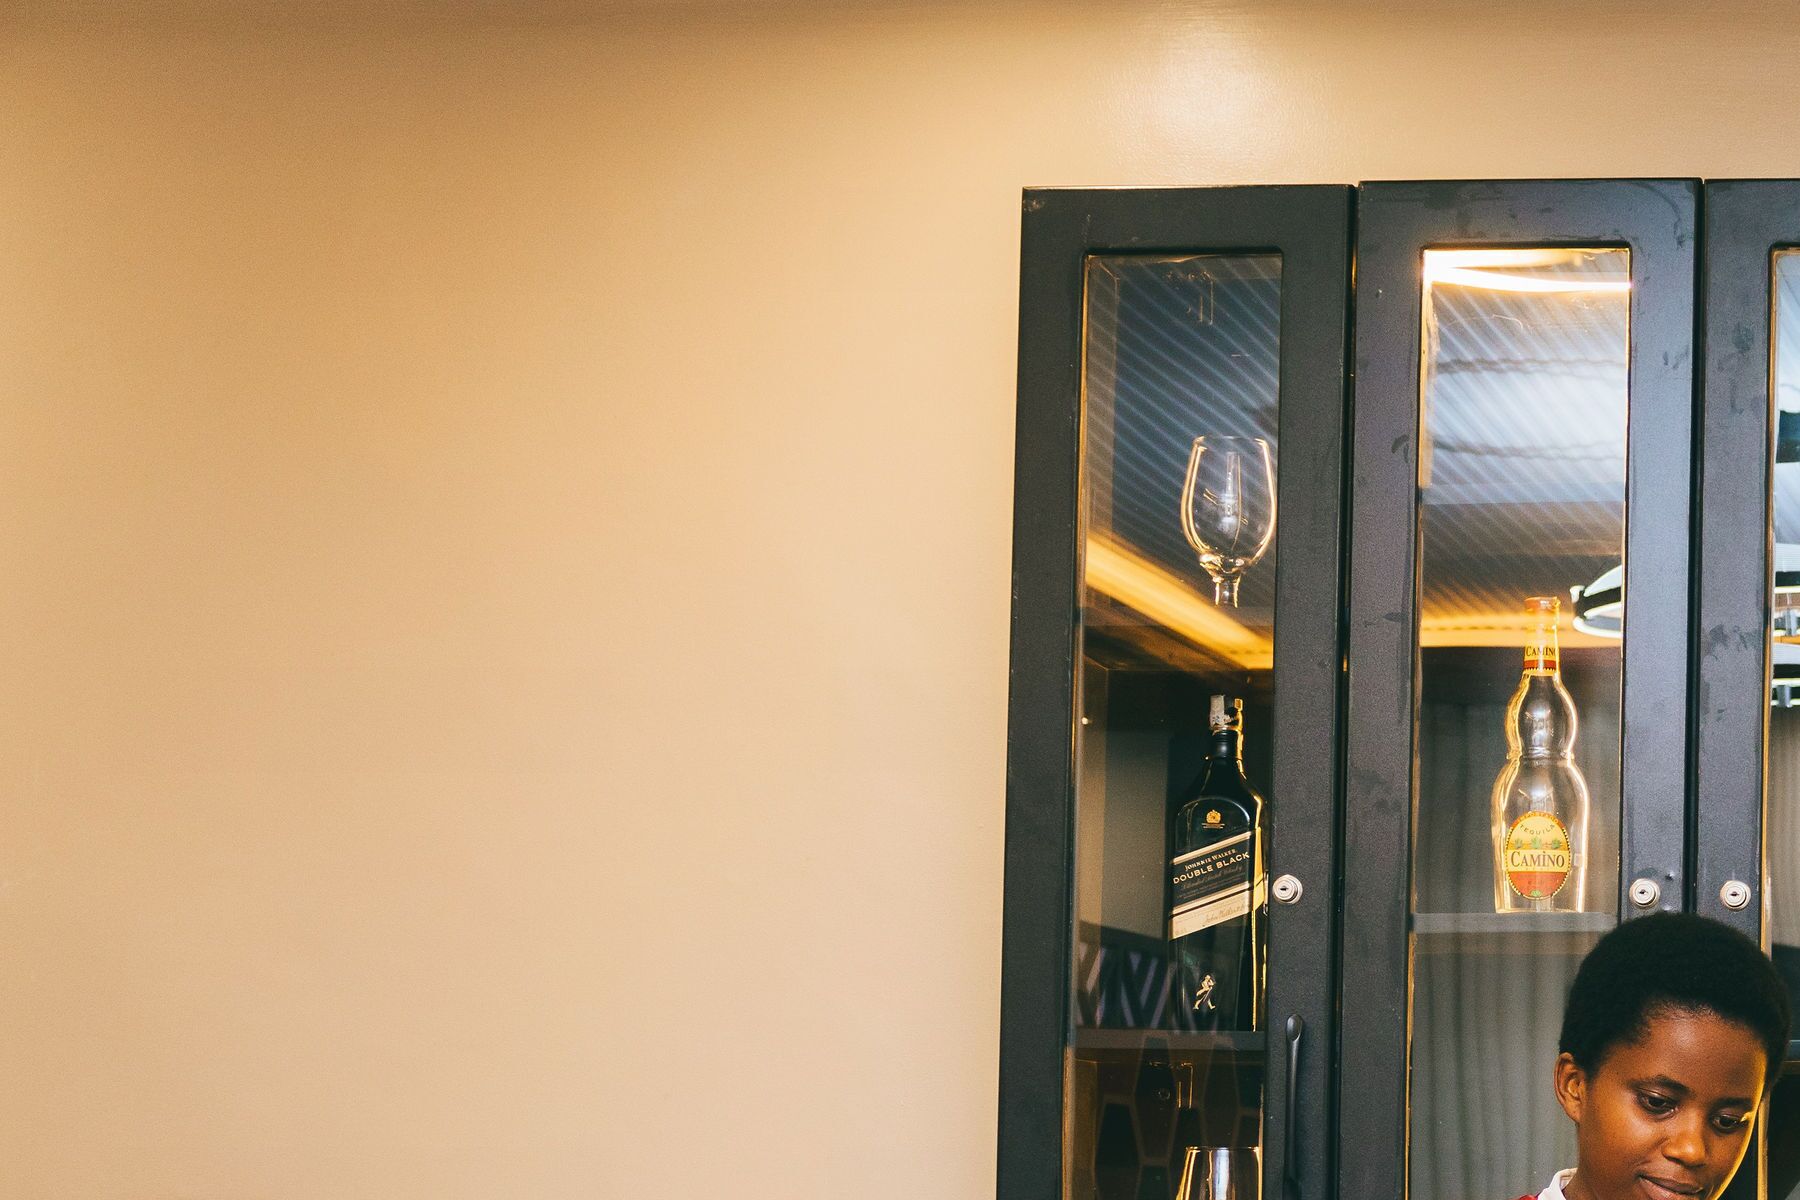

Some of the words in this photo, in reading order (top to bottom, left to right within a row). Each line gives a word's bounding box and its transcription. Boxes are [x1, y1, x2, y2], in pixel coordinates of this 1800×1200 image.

[1520, 824, 1555, 836] TEQUILA
[1173, 864, 1214, 884] DOUBLE
[1216, 851, 1250, 869] BLACK
[1510, 850, 1565, 868] CAMINO
